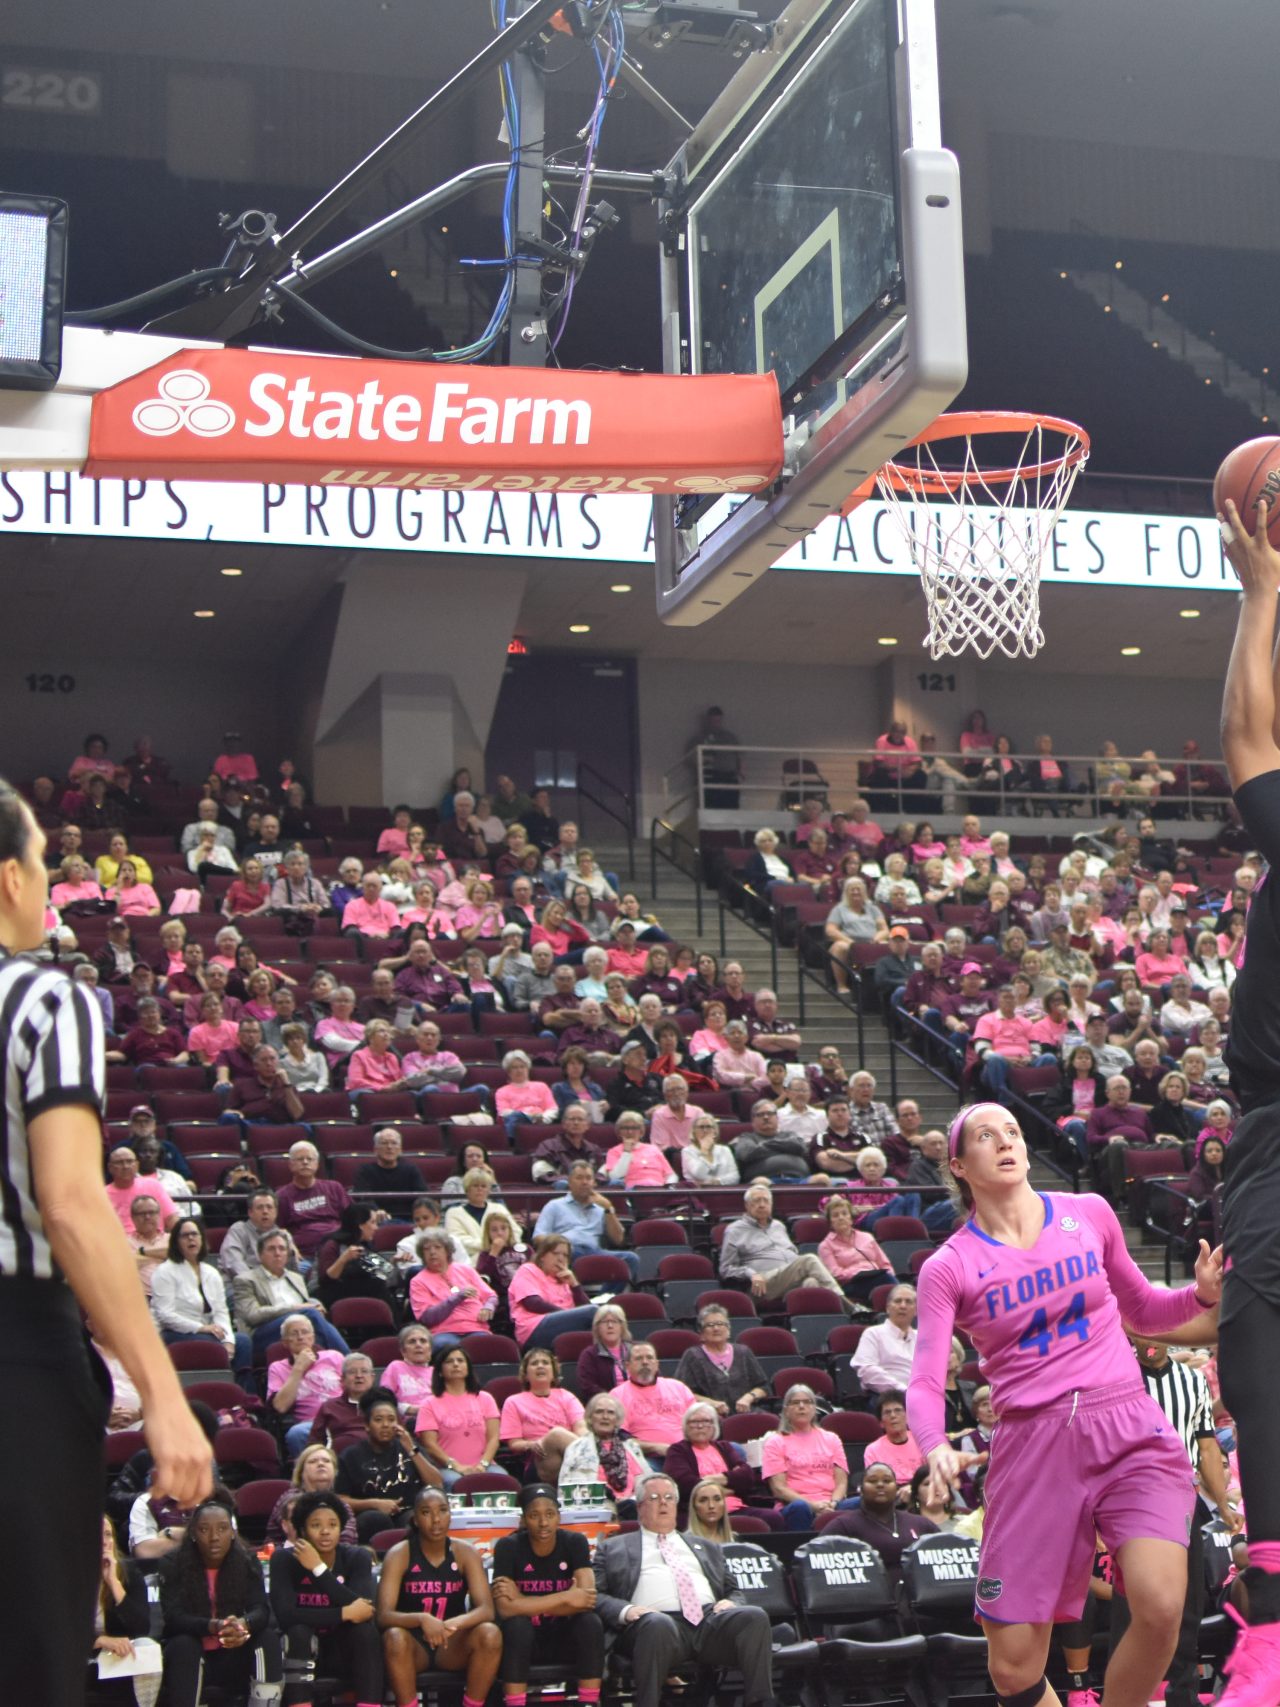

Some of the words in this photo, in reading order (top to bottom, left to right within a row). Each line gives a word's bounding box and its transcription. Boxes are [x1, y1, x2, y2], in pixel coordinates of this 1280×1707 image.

[1, 72, 100, 110] 220
[262, 482, 602, 551] PROGRAMS
[26, 673, 75, 694] 120
[917, 672, 957, 693] 121
[985, 1250, 1100, 1320] FLORIDA
[1018, 1292, 1092, 1357] 44
[809, 1551, 874, 1570] MUSCLE
[405, 1581, 442, 1594] TEXAS
